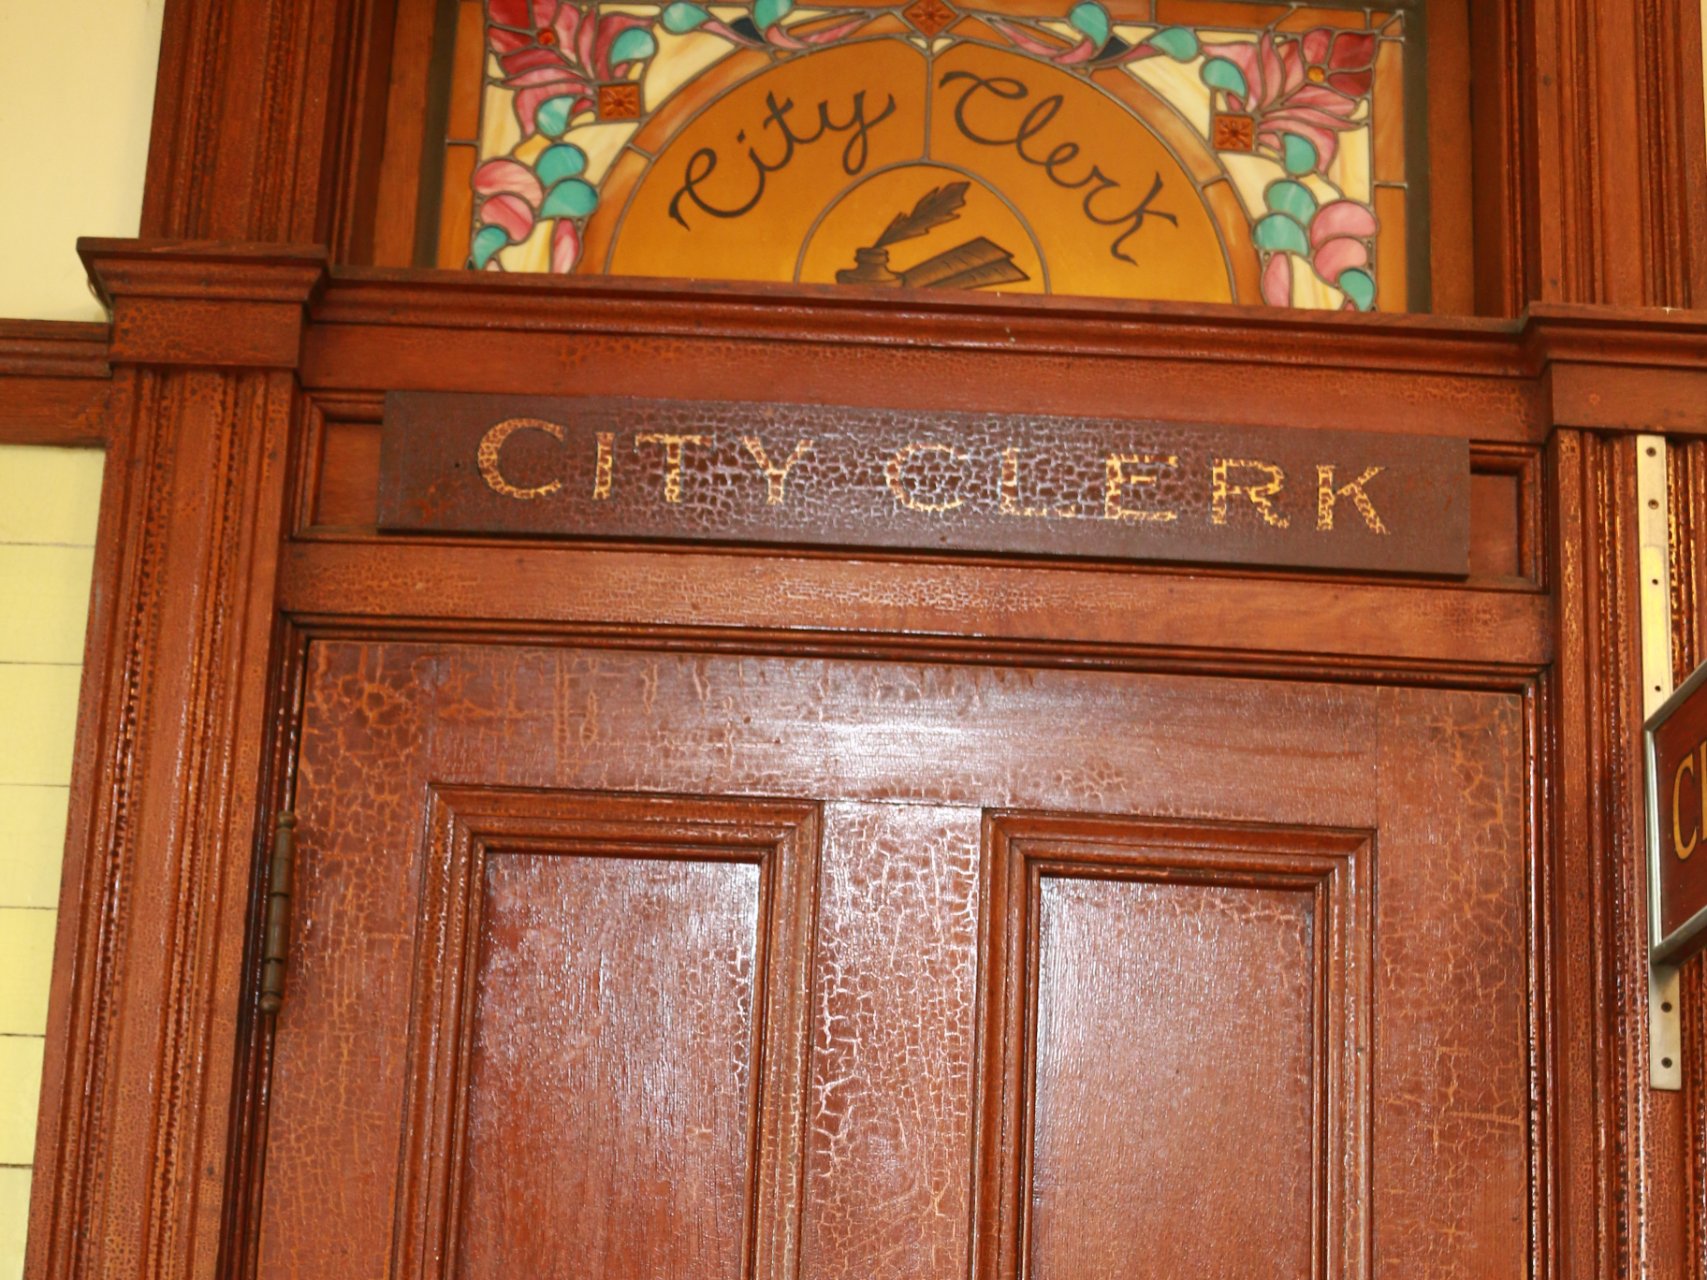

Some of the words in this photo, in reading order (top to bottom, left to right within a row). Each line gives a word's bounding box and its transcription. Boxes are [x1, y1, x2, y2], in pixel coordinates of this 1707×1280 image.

[668, 89, 896, 230] City
[939, 70, 1179, 266] Clerk
[477, 417, 815, 504] CITY
[886, 442, 1391, 536] CLERK
